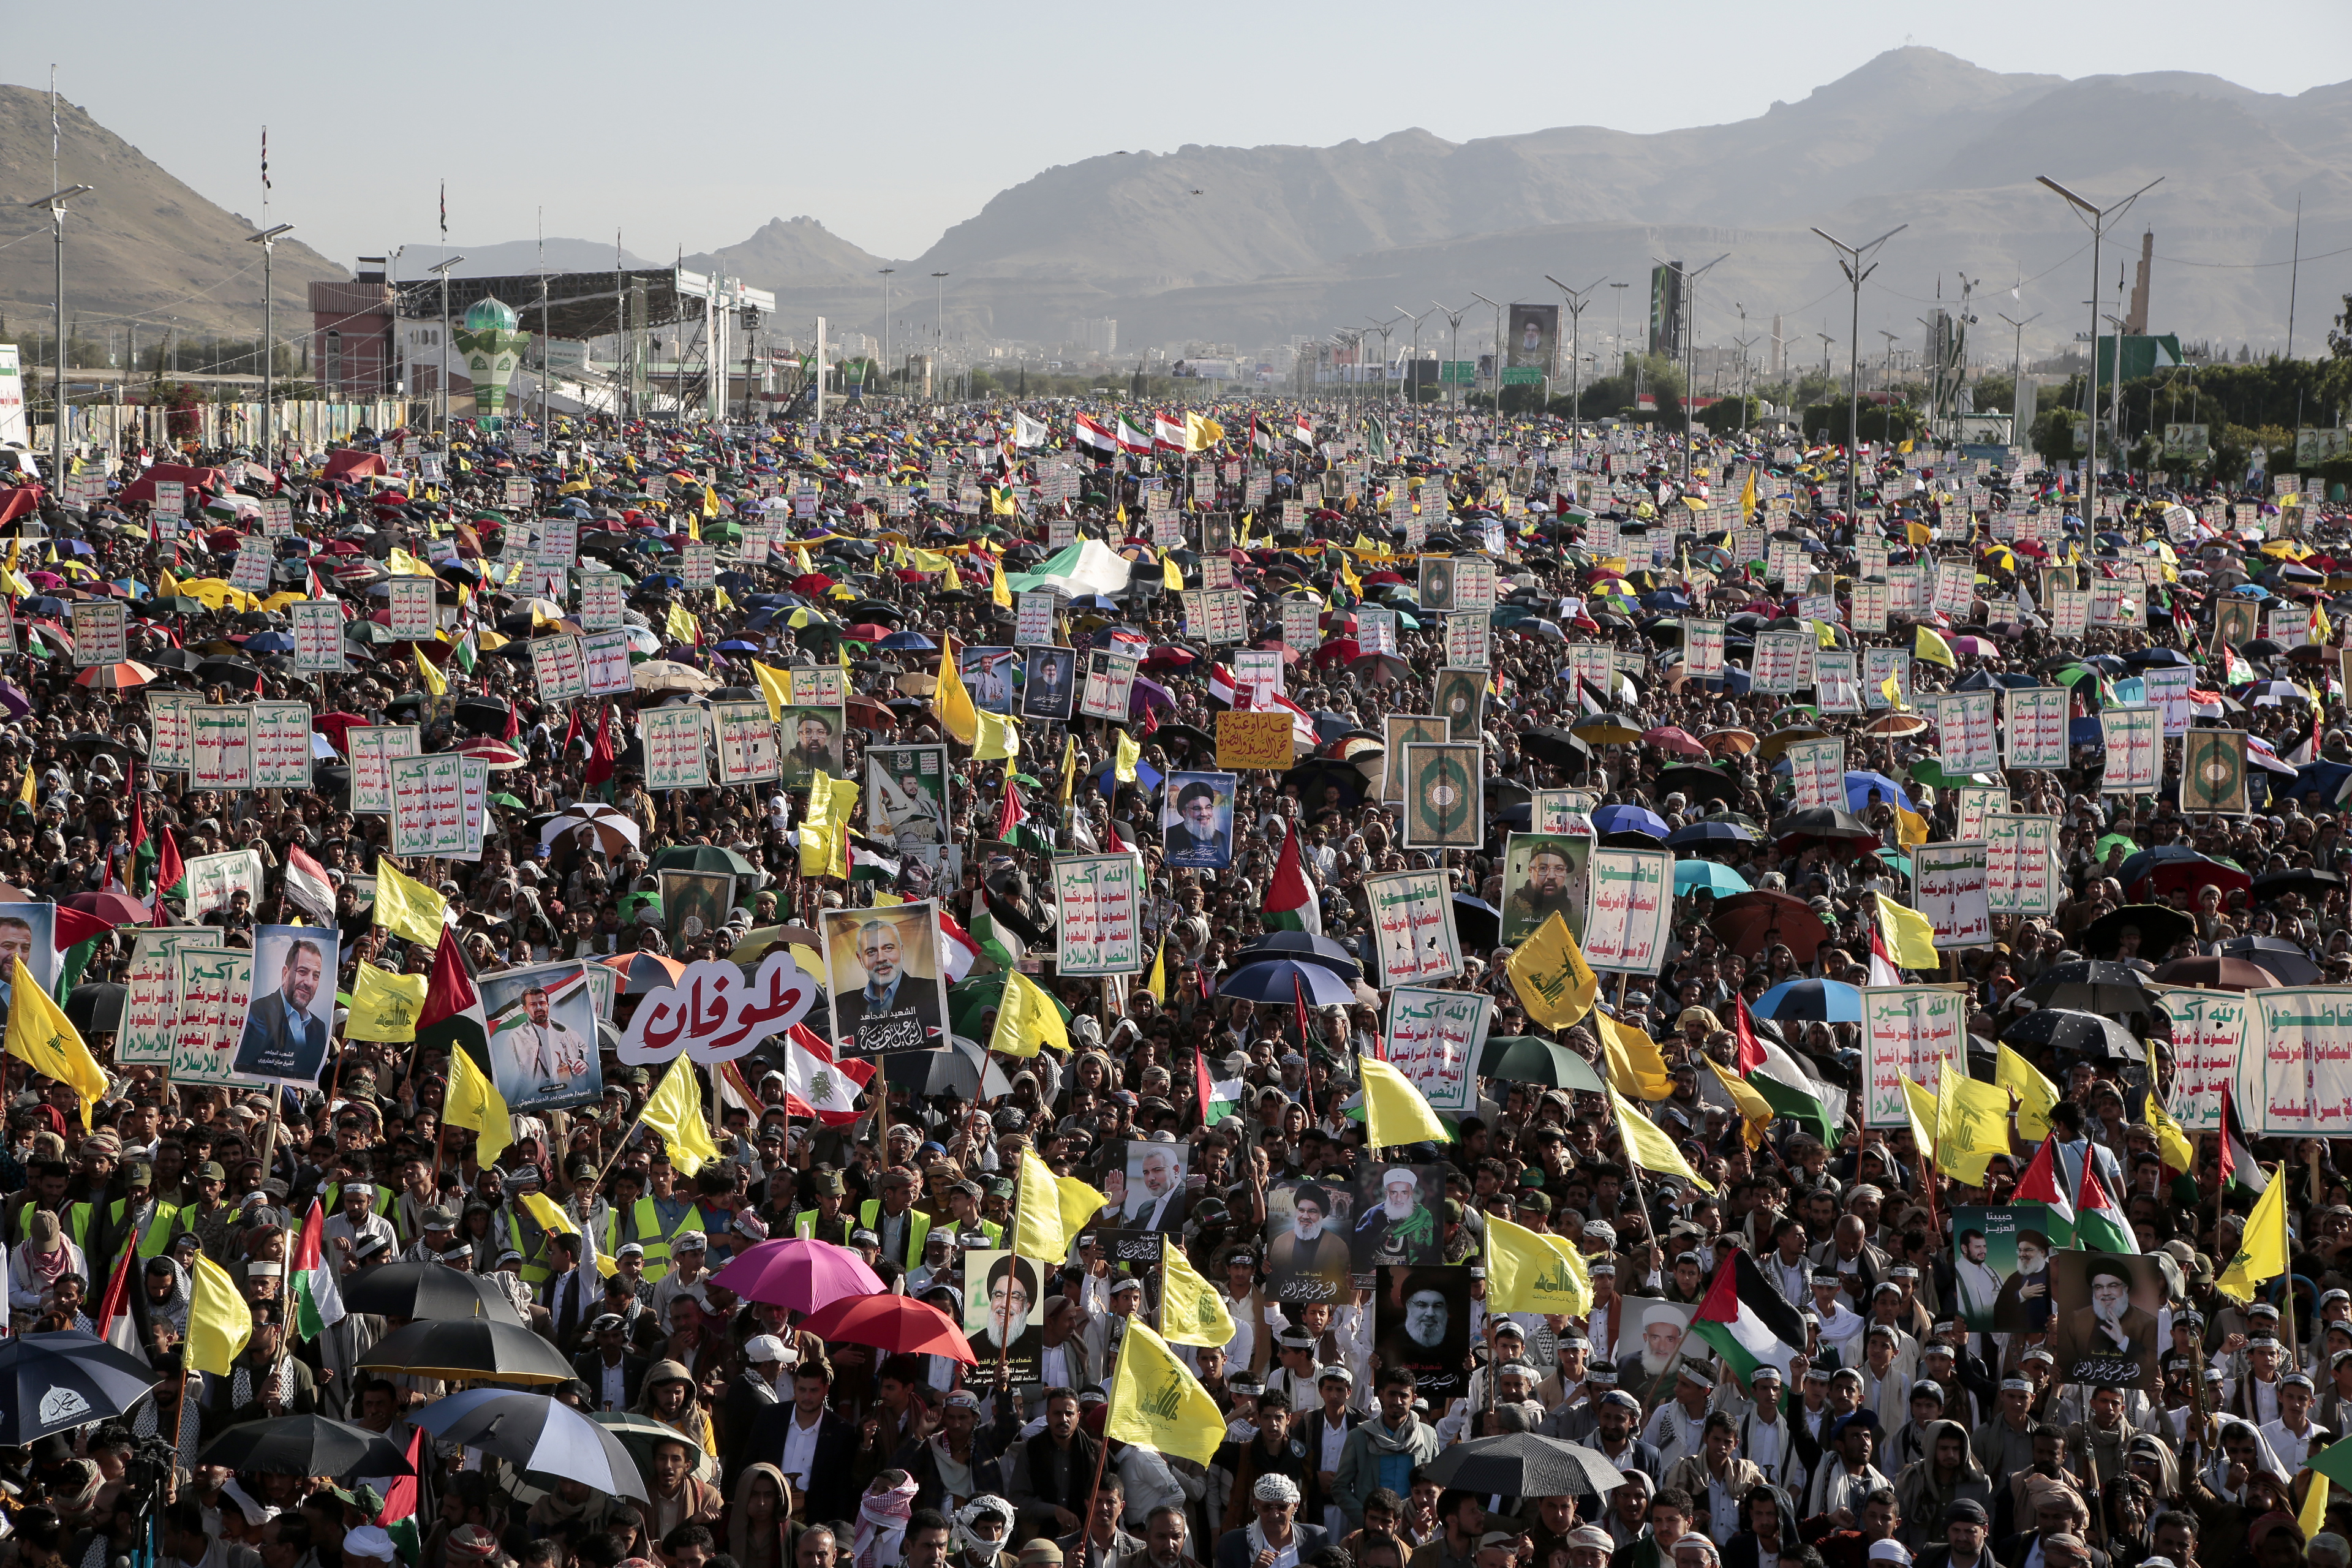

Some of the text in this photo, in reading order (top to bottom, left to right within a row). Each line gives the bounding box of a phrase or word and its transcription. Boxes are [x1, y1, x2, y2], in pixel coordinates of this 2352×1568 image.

[194, 714, 246, 730] قاطعوا
[195, 734, 246, 749] البضائع الأمريكية
[219, 752, 222, 763] و
[197, 767, 247, 782] الإسرائيلية
[396, 760, 456, 783] الله أكبر
[397, 781, 458, 796] الموت لأمريكا
[399, 797, 459, 813] الموت لإسرائيل
[399, 814, 459, 831] اللعنة على اليهود
[400, 829, 461, 850] النصر للإسلام
[1061, 862, 1129, 889] الله أكبر
[1597, 859, 1659, 884] قاطعوا
[1374, 881, 1438, 911] قاطعوا
[1920, 877, 1985, 897] البضائع الأمريكية
[1063, 888, 1129, 905] الموت لأمريكا
[1596, 889, 1657, 914] البضائع الأمريكية
[1065, 908, 1131, 925] الموت لإسرائيل
[1950, 901, 1955, 914] و
[1381, 908, 1441, 933] البضائع الأمريكية
[1618, 917, 1623, 932] و
[1066, 928, 1131, 944] اللعنة على اليهود
[1411, 936, 1415, 949] و
[1065, 944, 1133, 970] النصر للإسلام
[1587, 938, 1651, 961] الإسرائيلية
[187, 957, 239, 984] أكبر
[1387, 951, 1450, 978] الإسرائيلية
[185, 986, 228, 1004] لأمريكا
[637, 967, 801, 1050] طوفان
[861, 1006, 916, 1021] الشهيد المجاهد
[1395, 996, 1475, 1023] الله أكبر
[1872, 993, 1956, 1022] الله أكبر
[2209, 1002, 2243, 1023] الله
[181, 1008, 226, 1029] لإسرائيل
[1394, 1023, 1469, 1044] الموت لأمريكا
[1873, 1021, 1956, 1042] الموت لأمريكا
[2203, 1032, 2239, 1047] الموت
[177, 1032, 230, 1050] على اليهود
[2268, 1036, 2312, 1064] الأمريكية
[1390, 1046, 1431, 1063] لإسرائيل
[1874, 1047, 1919, 1068] لإسرائيل
[2203, 1054, 2236, 1071] الموت
[173, 1052, 219, 1079] للإسلام
[1418, 1065, 1463, 1081] اللعنة على
[2188, 1077, 2204, 1096] على
[2307, 1069, 2313, 1088] و
[517, 1098, 535, 1109] الحوثي
[1986, 1212, 2012, 1221] حبيبنا
[1985, 1224, 2015, 1234] العزيز
[1431, 1373, 1459, 1390] السيد
